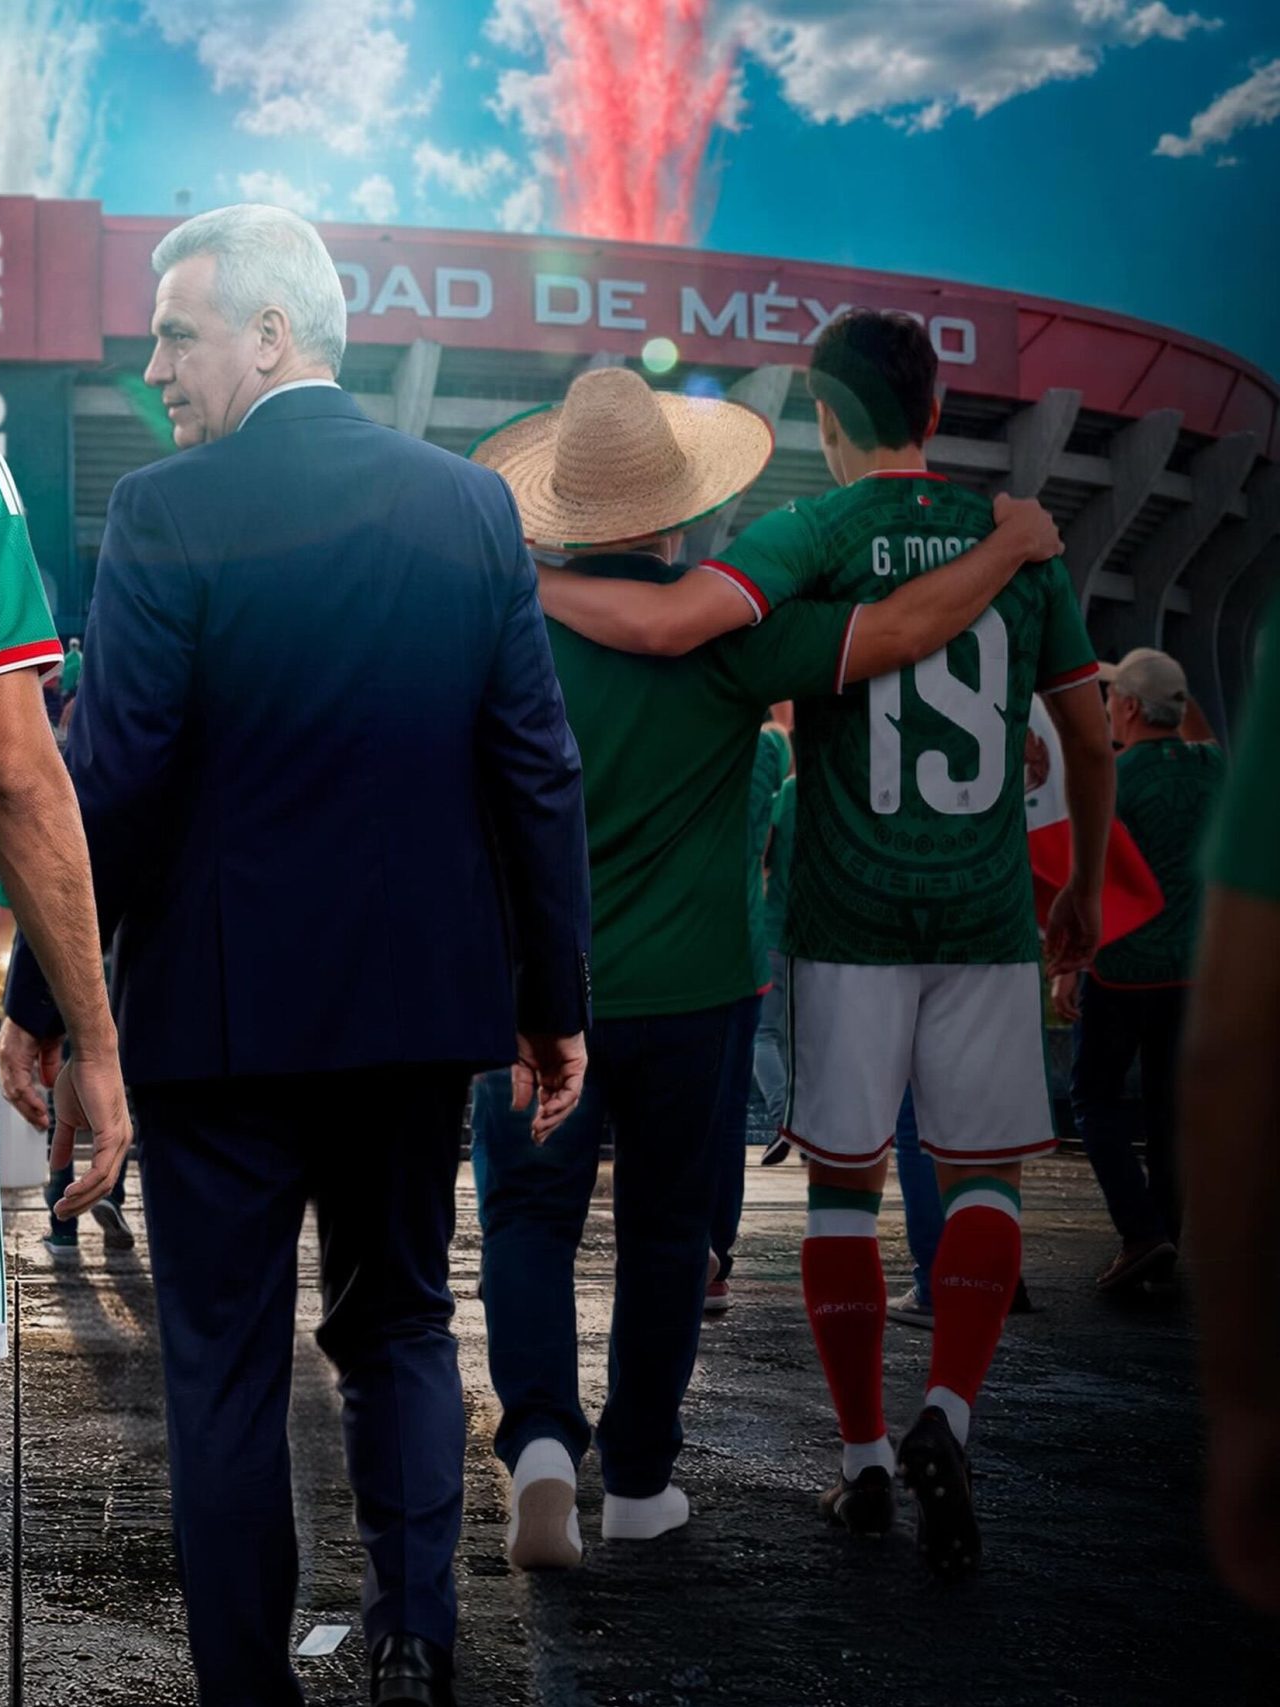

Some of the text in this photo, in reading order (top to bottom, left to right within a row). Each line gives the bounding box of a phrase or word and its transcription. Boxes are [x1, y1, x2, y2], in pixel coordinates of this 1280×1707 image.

[334, 261, 493, 319] DAD
[535, 273, 647, 330] DE
[680, 281, 977, 365] MÉXO
[872, 536, 980, 576] G. MOR
